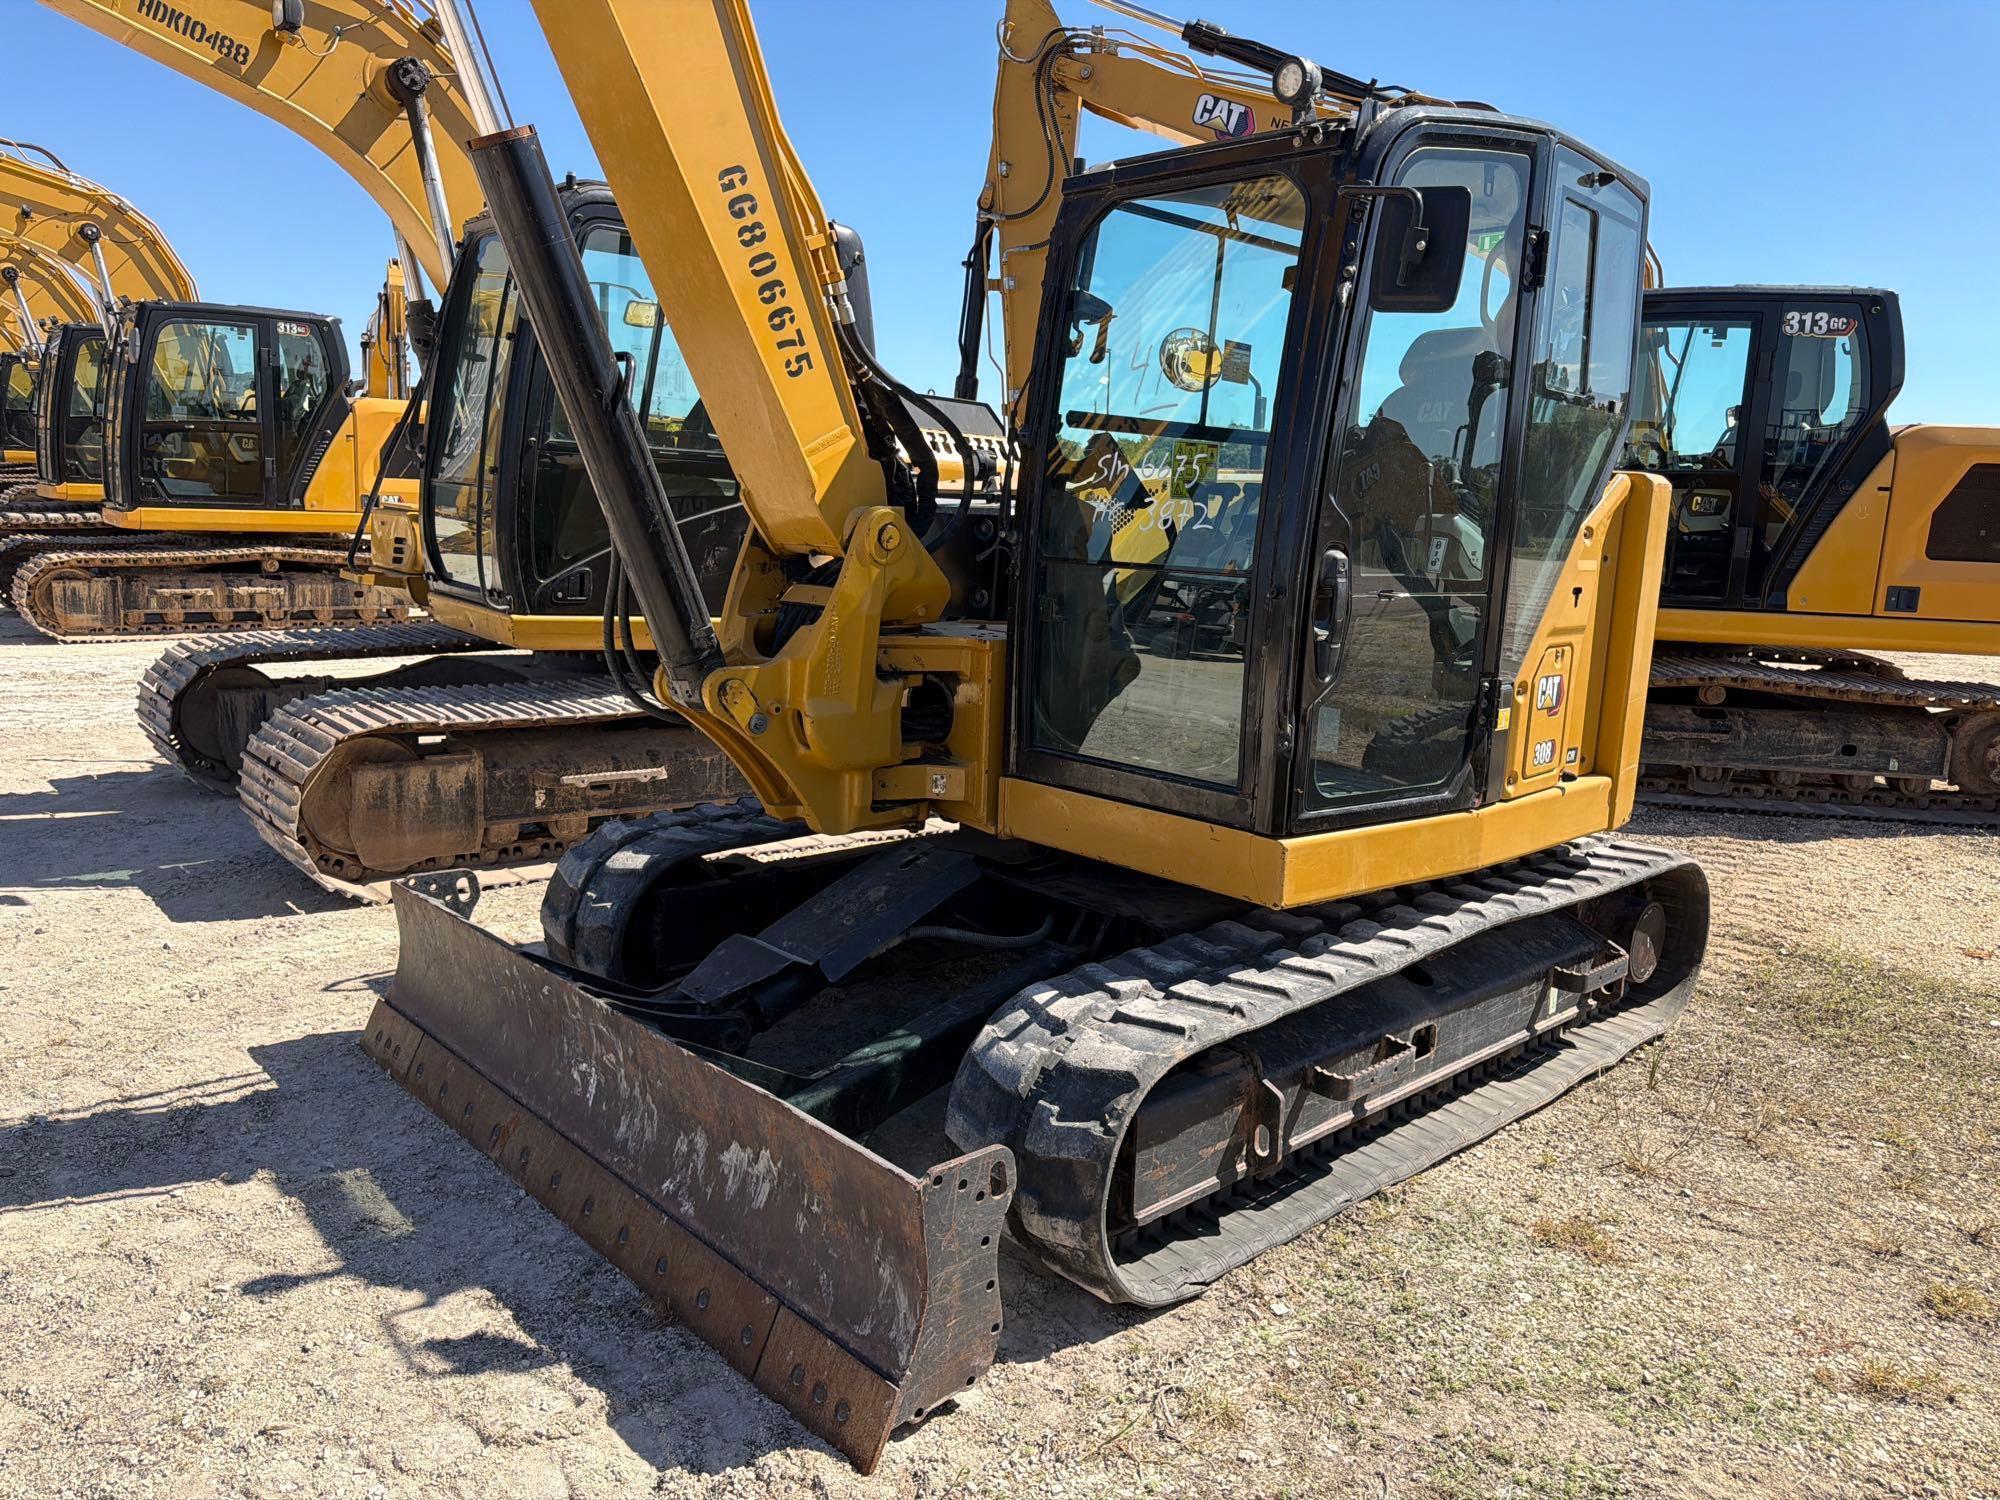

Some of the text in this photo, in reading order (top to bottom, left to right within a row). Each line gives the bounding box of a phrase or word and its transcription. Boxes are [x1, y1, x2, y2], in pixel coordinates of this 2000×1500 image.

[137, 0, 250, 65] HDK10488
[1193, 94, 1246, 135] CAT
[718, 165, 814, 378] GG806675
[277, 321, 297, 334] 313
[1785, 311, 1848, 335] 313 GC
[1141, 451, 1207, 488] 6675
[382, 495, 400, 503] CAT
[1139, 498, 1214, 531] 3872
[1692, 496, 1718, 513] CAT
[1537, 676, 1561, 709] CAT
[1533, 741, 1553, 766] 308
